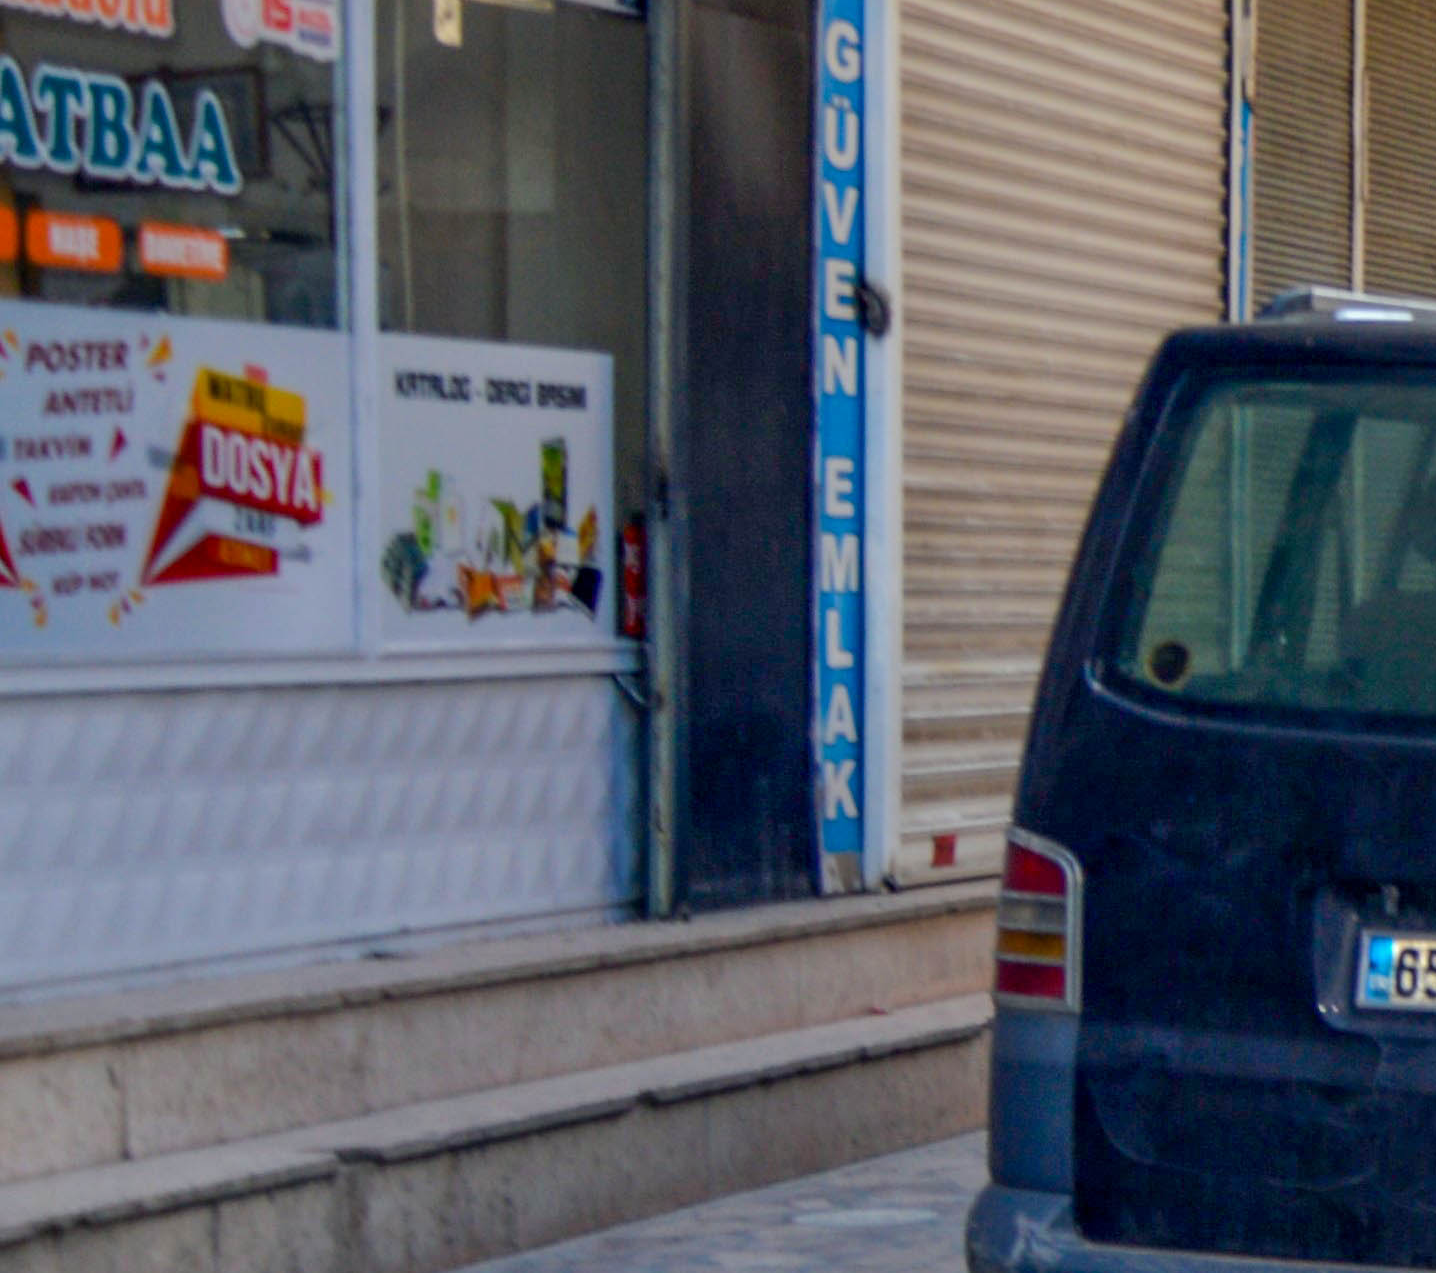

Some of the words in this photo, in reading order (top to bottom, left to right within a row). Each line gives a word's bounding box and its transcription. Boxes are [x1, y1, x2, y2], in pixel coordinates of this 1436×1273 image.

[822, 19, 861, 398] GÜVEN
[25, 339, 129, 373] POSTER
[201, 425, 319, 513] DOSYA
[820, 457, 860, 824] EMLAK
